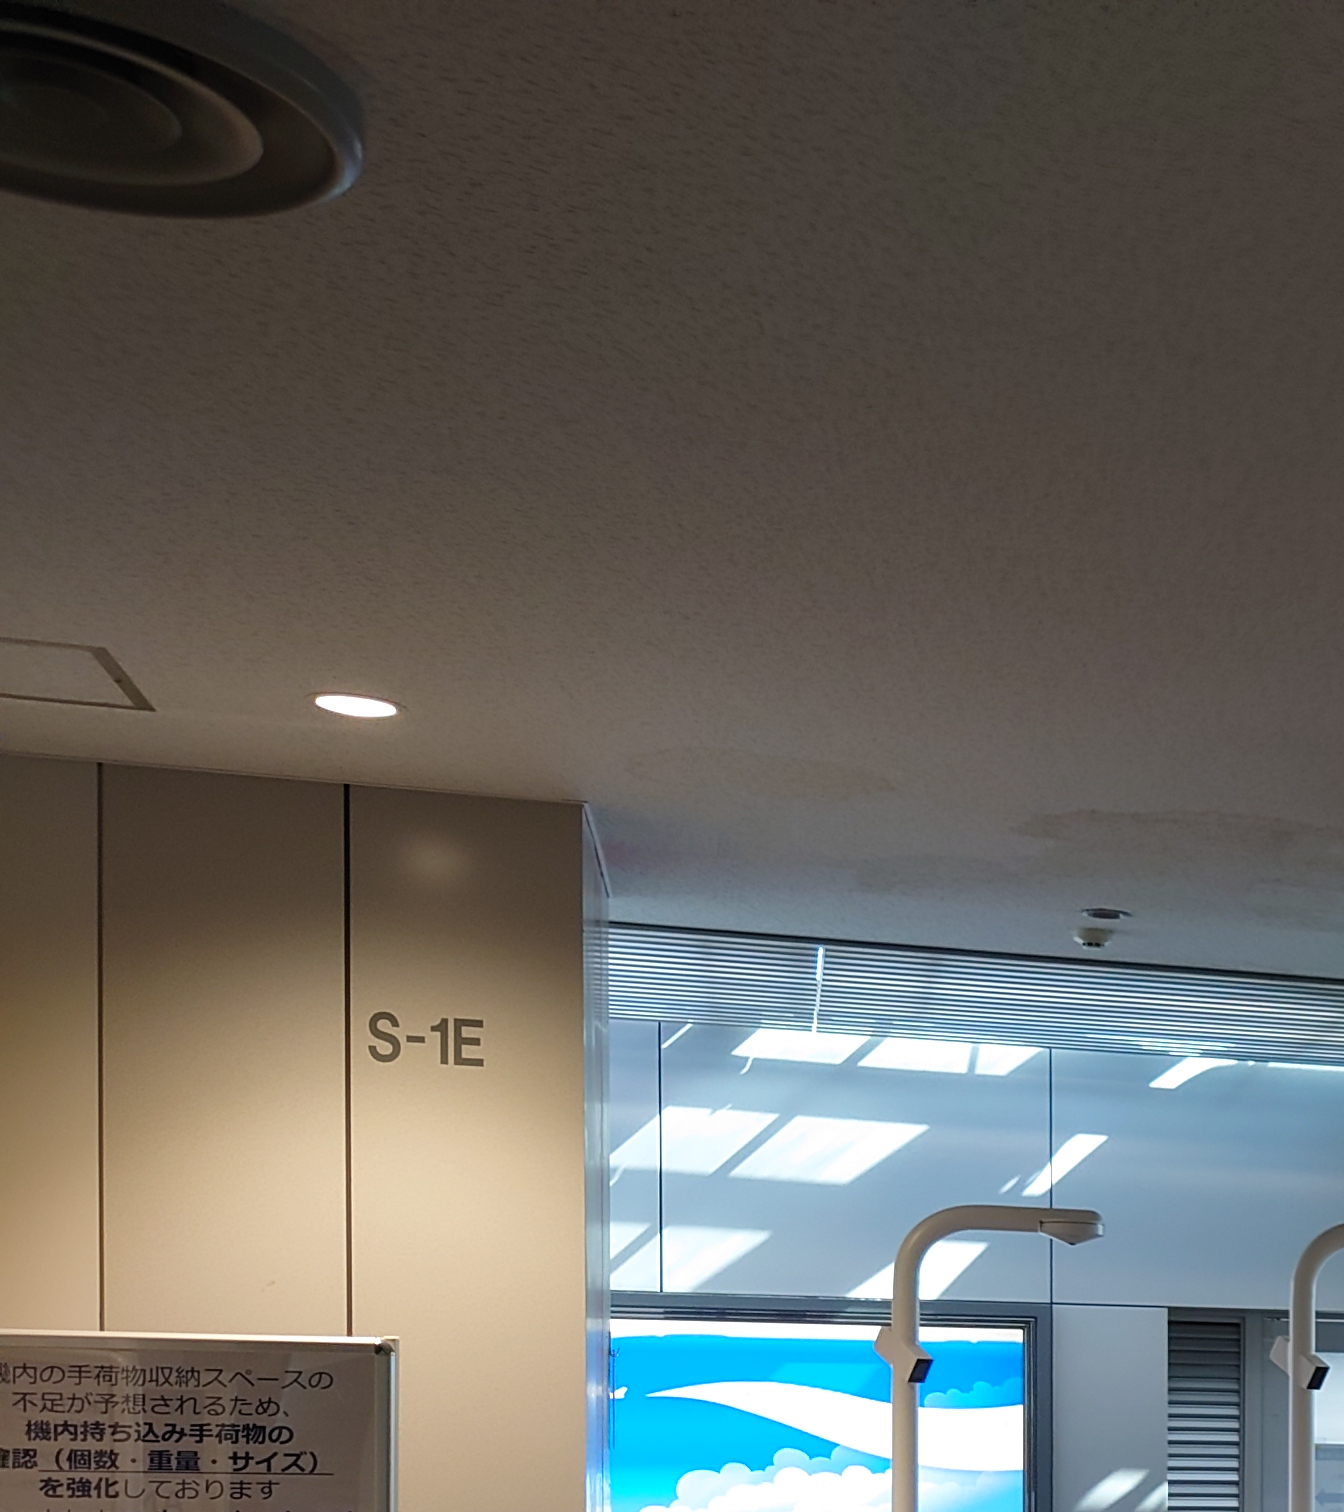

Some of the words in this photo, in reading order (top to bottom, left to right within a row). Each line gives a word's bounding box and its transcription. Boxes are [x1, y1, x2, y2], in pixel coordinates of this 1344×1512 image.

[367, 1011, 485, 1067] S-1E
[12, 1391, 289, 1417] 不足が予想されるため、
[25, 1419, 295, 1445] 機内持ち込み手荷物の
[39, 1477, 280, 1500] を強化しております
